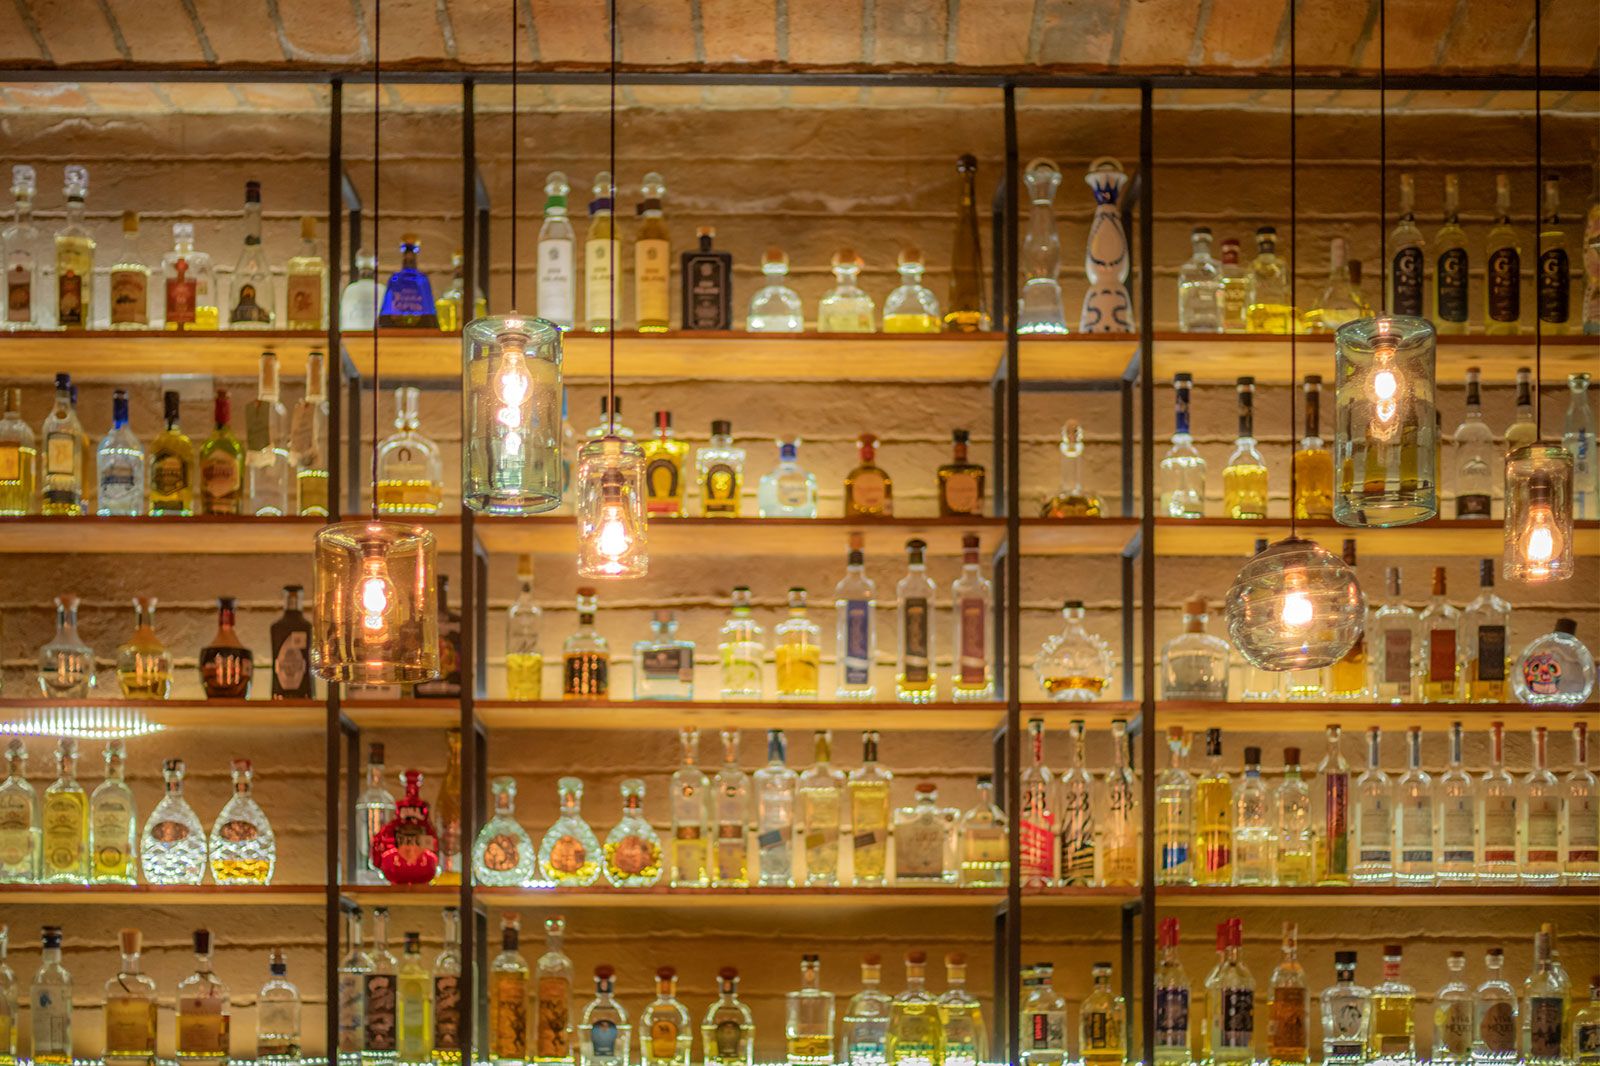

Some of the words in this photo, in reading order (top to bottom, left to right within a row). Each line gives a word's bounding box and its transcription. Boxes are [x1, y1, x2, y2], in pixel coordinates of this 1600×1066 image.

[1400, 256, 1415, 273] G
[1445, 258, 1459, 273] G
[1495, 257, 1509, 273] G
[1544, 259, 1559, 274] G
[1066, 792, 1089, 811] 23
